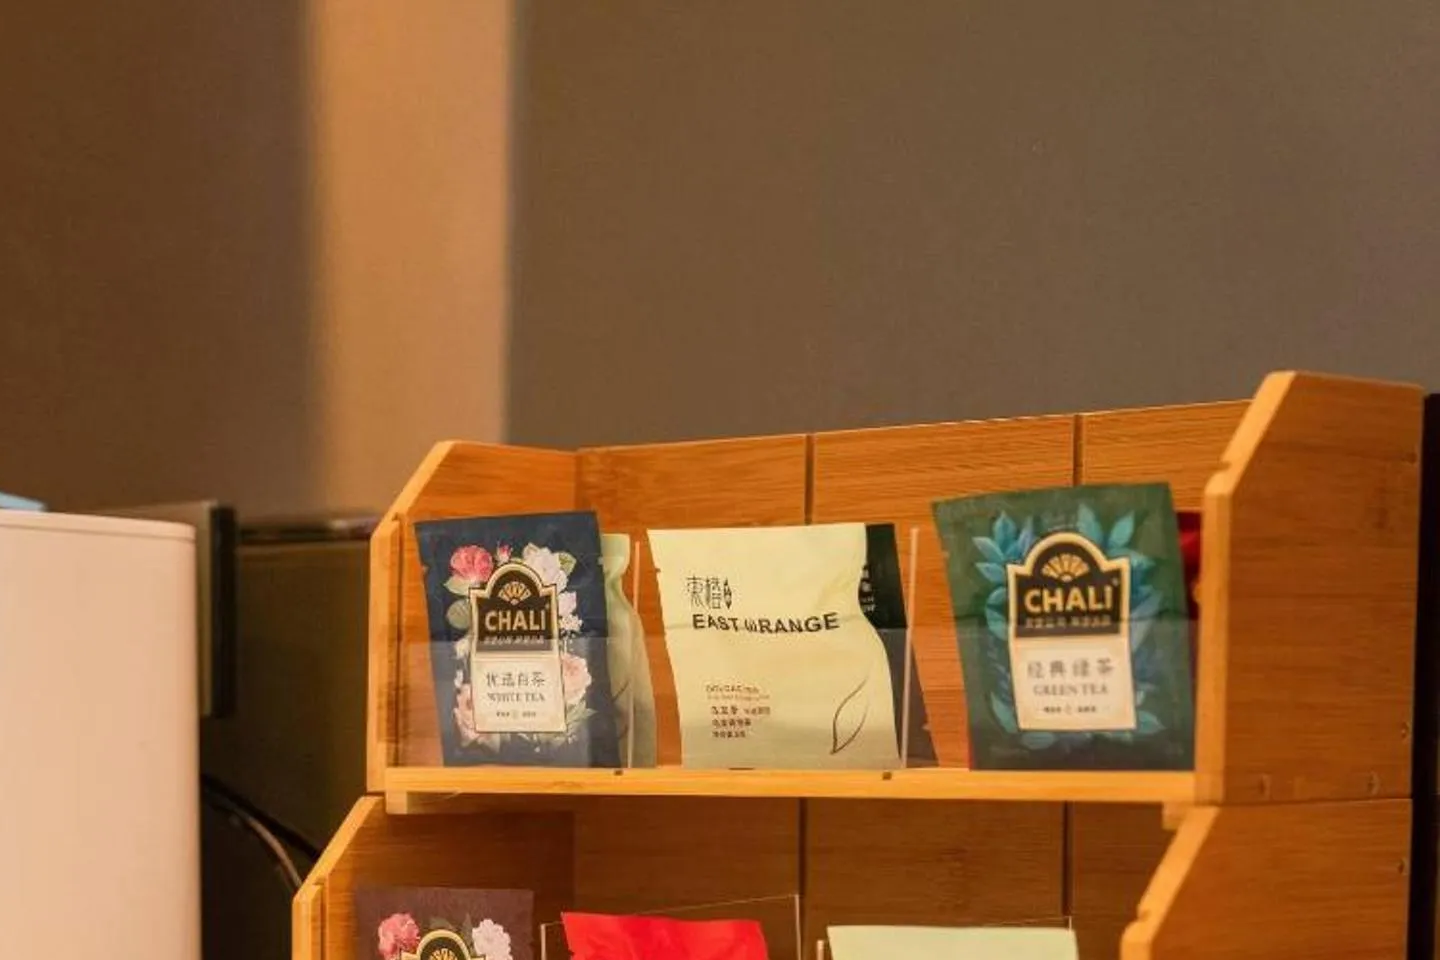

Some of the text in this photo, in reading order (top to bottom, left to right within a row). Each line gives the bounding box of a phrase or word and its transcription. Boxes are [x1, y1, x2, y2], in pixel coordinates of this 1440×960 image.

[1024, 585, 1113, 614] CHALI
[484, 609, 546, 632] CHALI
[692, 613, 738, 633] EAST
